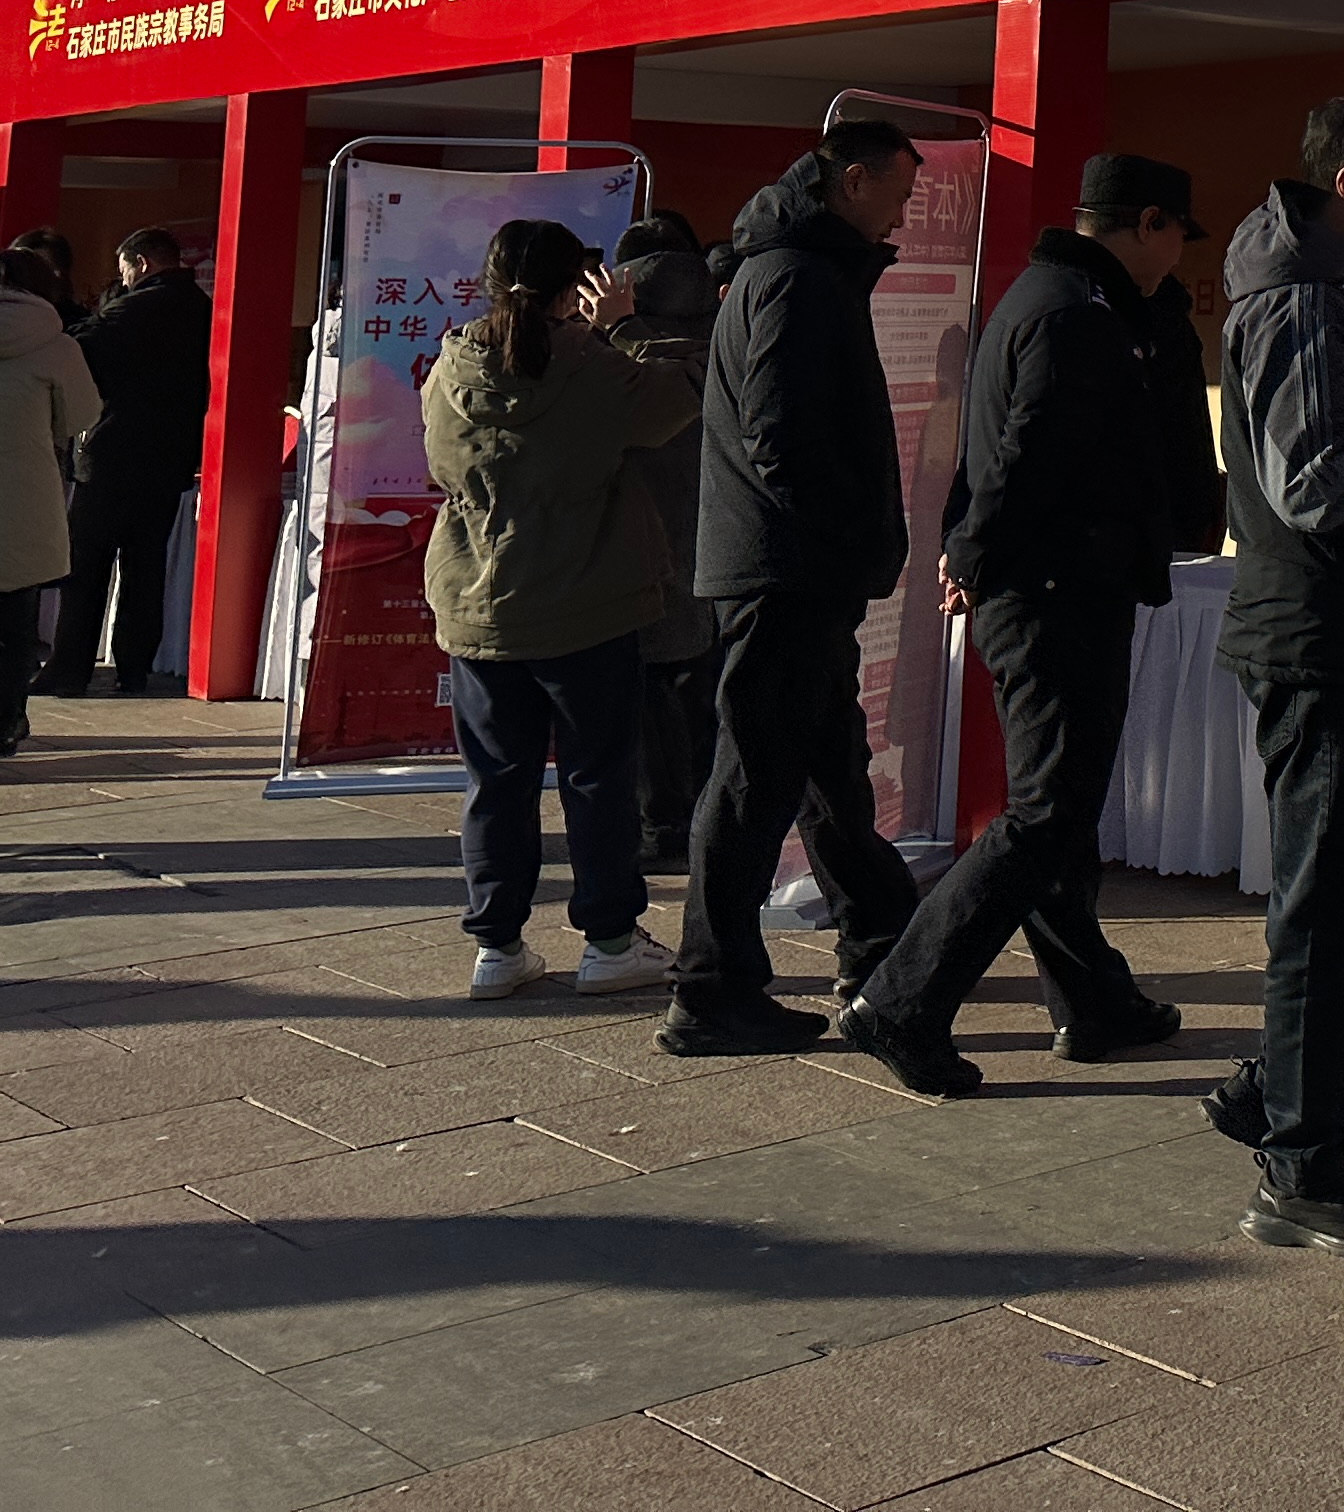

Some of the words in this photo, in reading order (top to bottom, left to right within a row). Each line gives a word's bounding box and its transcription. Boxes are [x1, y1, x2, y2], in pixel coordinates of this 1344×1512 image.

[66, 0, 225, 60] 石家庄市民族宗教事务局
